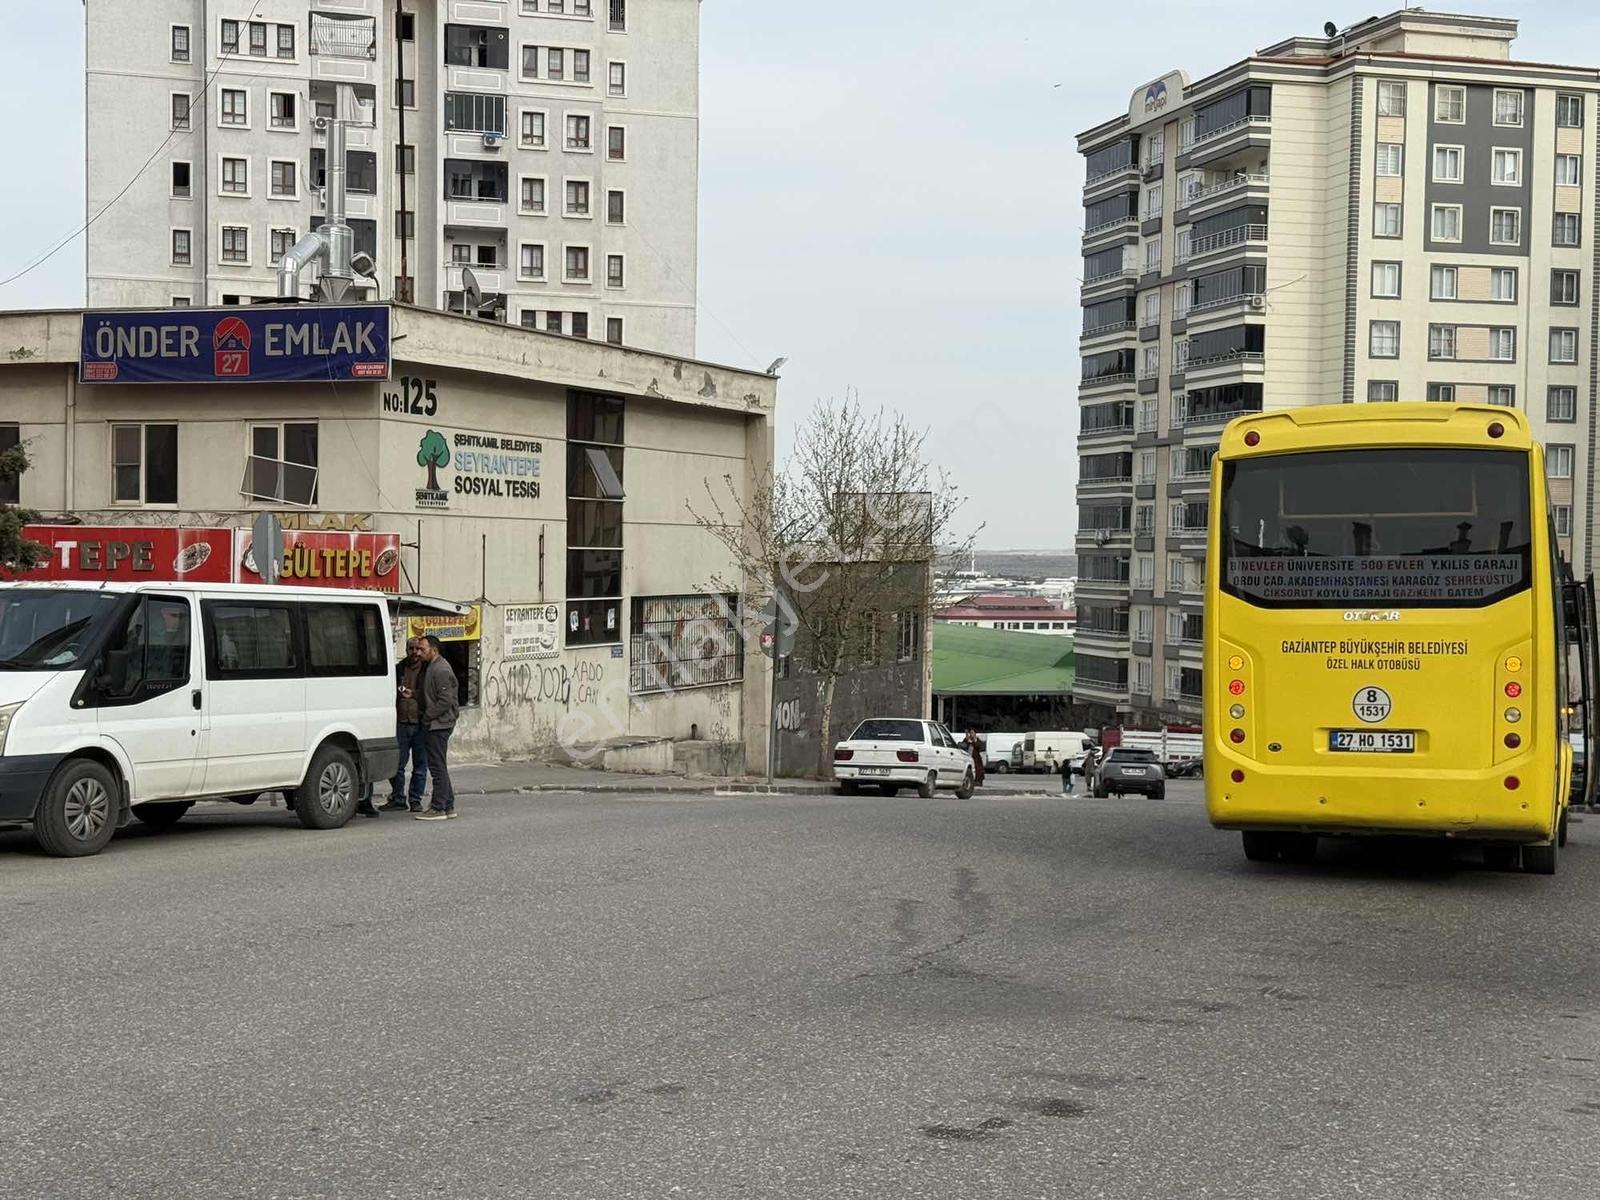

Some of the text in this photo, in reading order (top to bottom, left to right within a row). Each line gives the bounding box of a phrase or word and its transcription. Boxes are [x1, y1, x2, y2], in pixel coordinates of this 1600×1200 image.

[95, 320, 377, 358] ÖNDER EMLAK
[221, 354, 242, 373] 27
[454, 450, 540, 477] SEYRANTEPE
[454, 475, 503, 496] SOSYAL
[280, 541, 372, 578] GÜLTEPE
[1360, 560, 1383, 570] 500
[1387, 560, 1424, 570] EVLER
[1233, 576, 1260, 586] ORDU
[1281, 639, 1468, 657] GAZİANTEP BÜYÜKŞEHİR BELEDİYESİ
[1326, 658, 1420, 670] ÖZEL HALK OTOBÜSÜ
[1366, 690, 1377, 703] 8
[1359, 706, 1385, 717] 1531
[1338, 734, 1353, 747] 27
[1381, 735, 1410, 748] 1531
